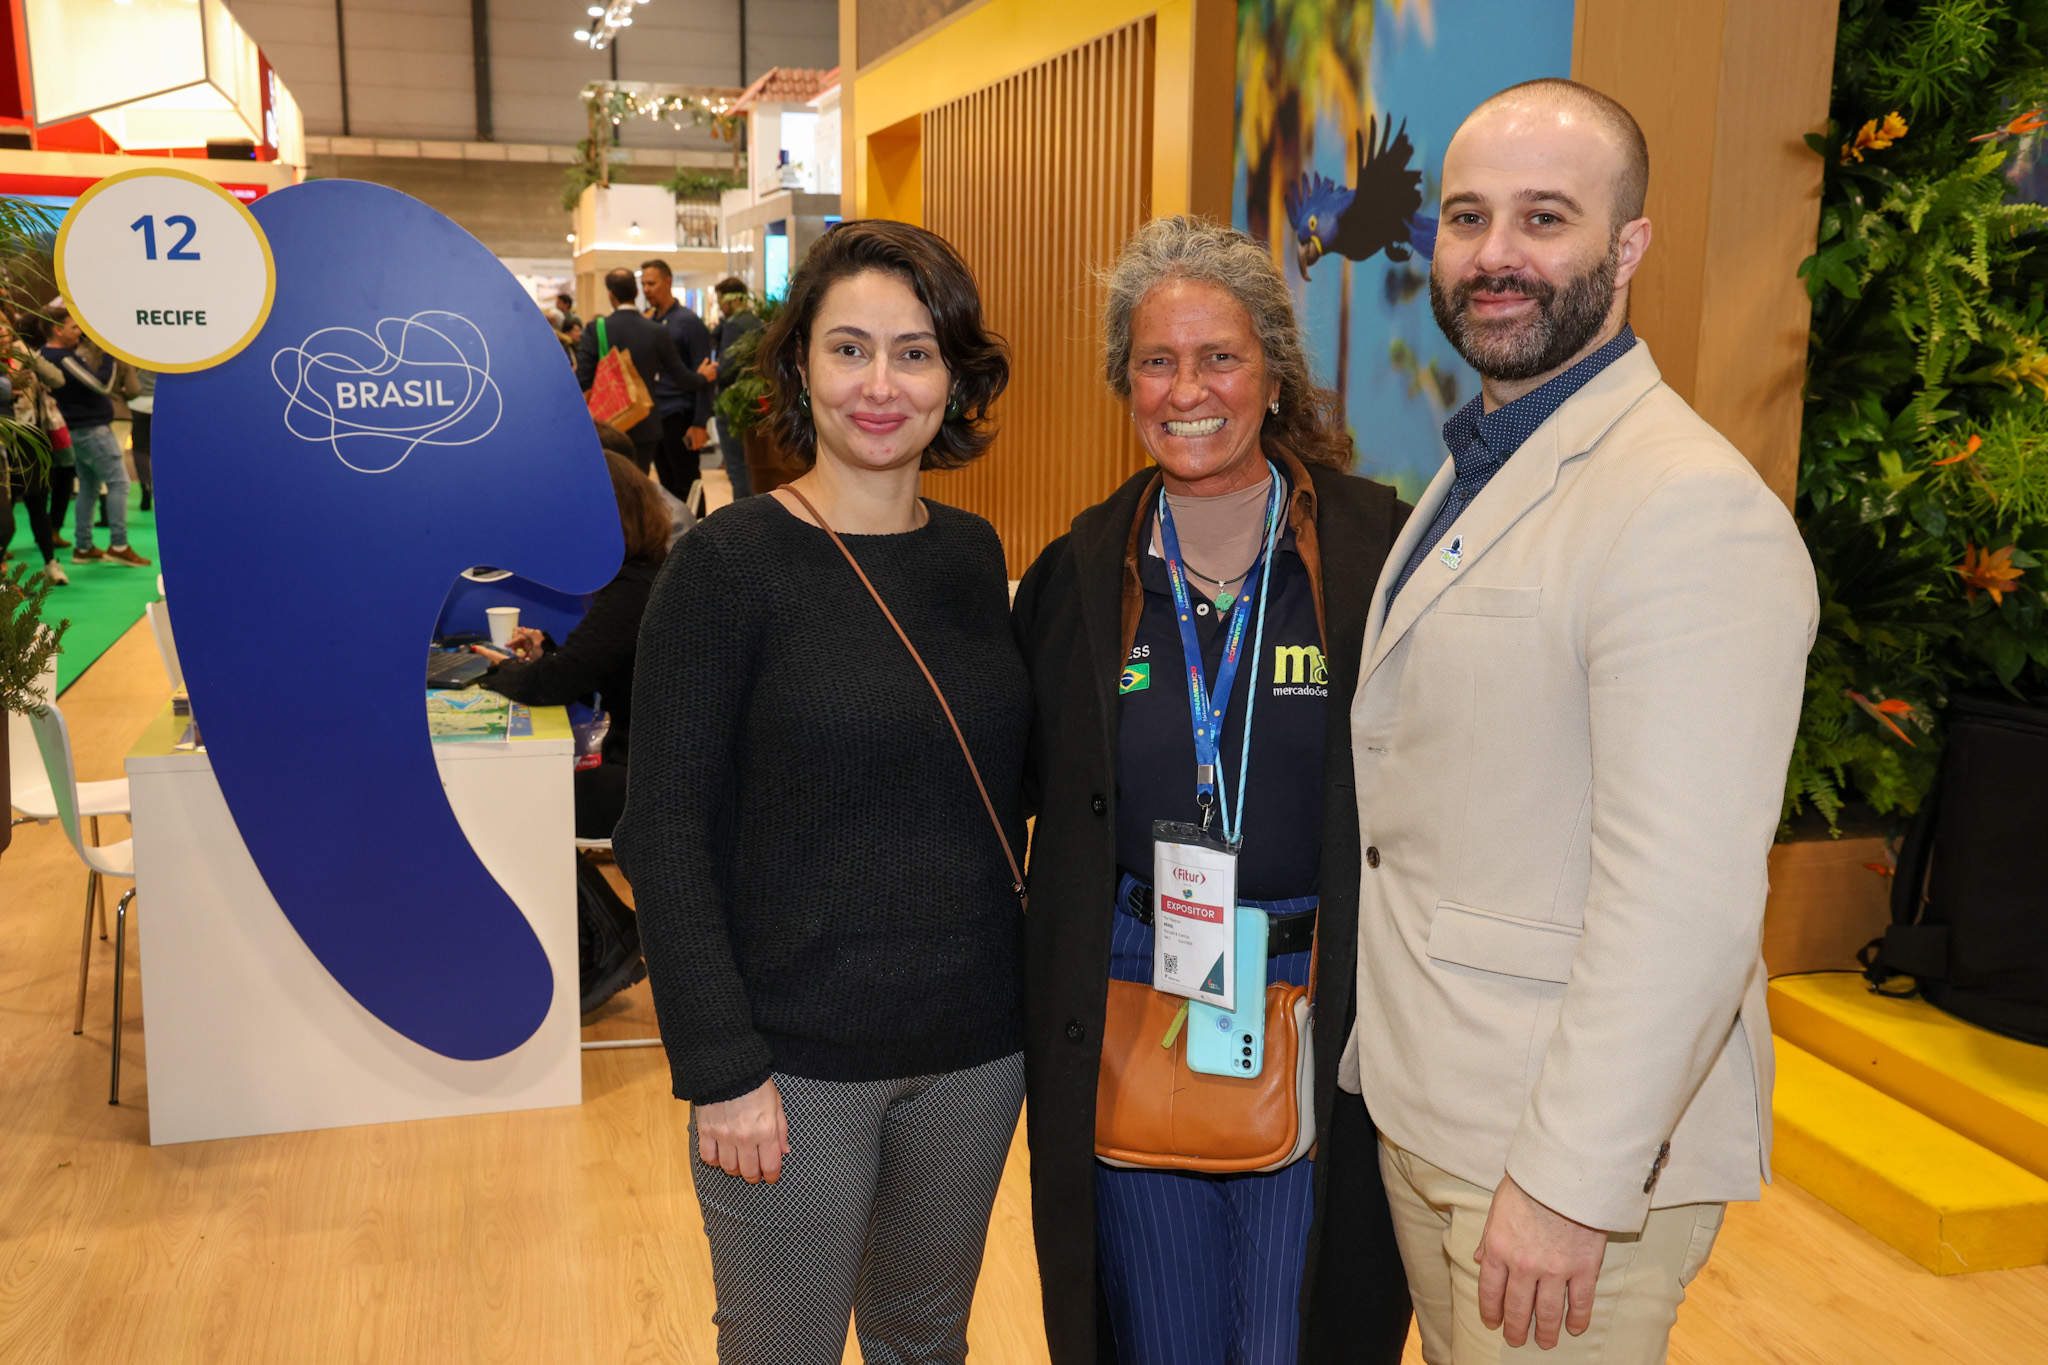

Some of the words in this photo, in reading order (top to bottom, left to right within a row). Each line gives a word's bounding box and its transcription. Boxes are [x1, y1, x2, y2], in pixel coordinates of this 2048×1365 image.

[130, 215, 201, 261] 12
[136, 310, 207, 326] RECIFE
[336, 379, 455, 409] BRASIL
[1169, 560, 1185, 611] ERNAMBUCO
[1228, 605, 1246, 663] ERNAMBUCO
[1190, 666, 1202, 722] ERNAMBUCO
[1166, 900, 1215, 919] EXPOSITOR
